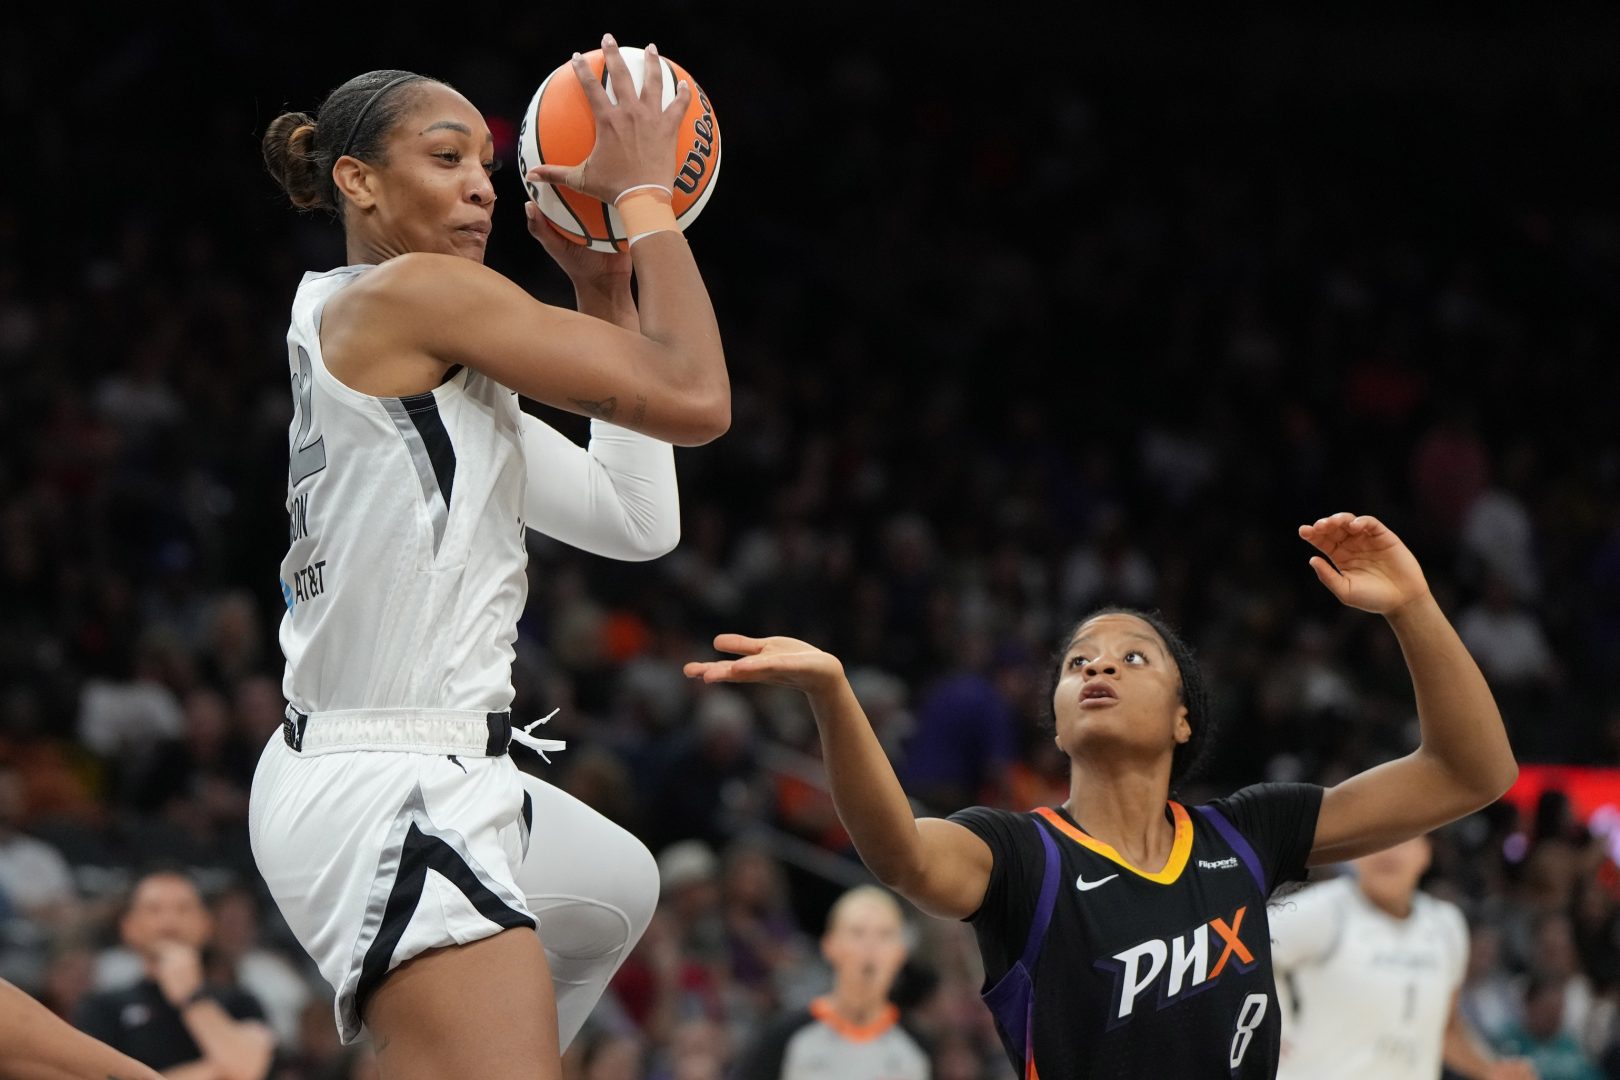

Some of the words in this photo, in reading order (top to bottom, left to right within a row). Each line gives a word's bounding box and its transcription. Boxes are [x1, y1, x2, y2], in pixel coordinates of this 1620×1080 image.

[294, 560, 326, 604] AT&T
[1112, 906, 1255, 1018] PHX
[1230, 993, 1267, 1069] 8
